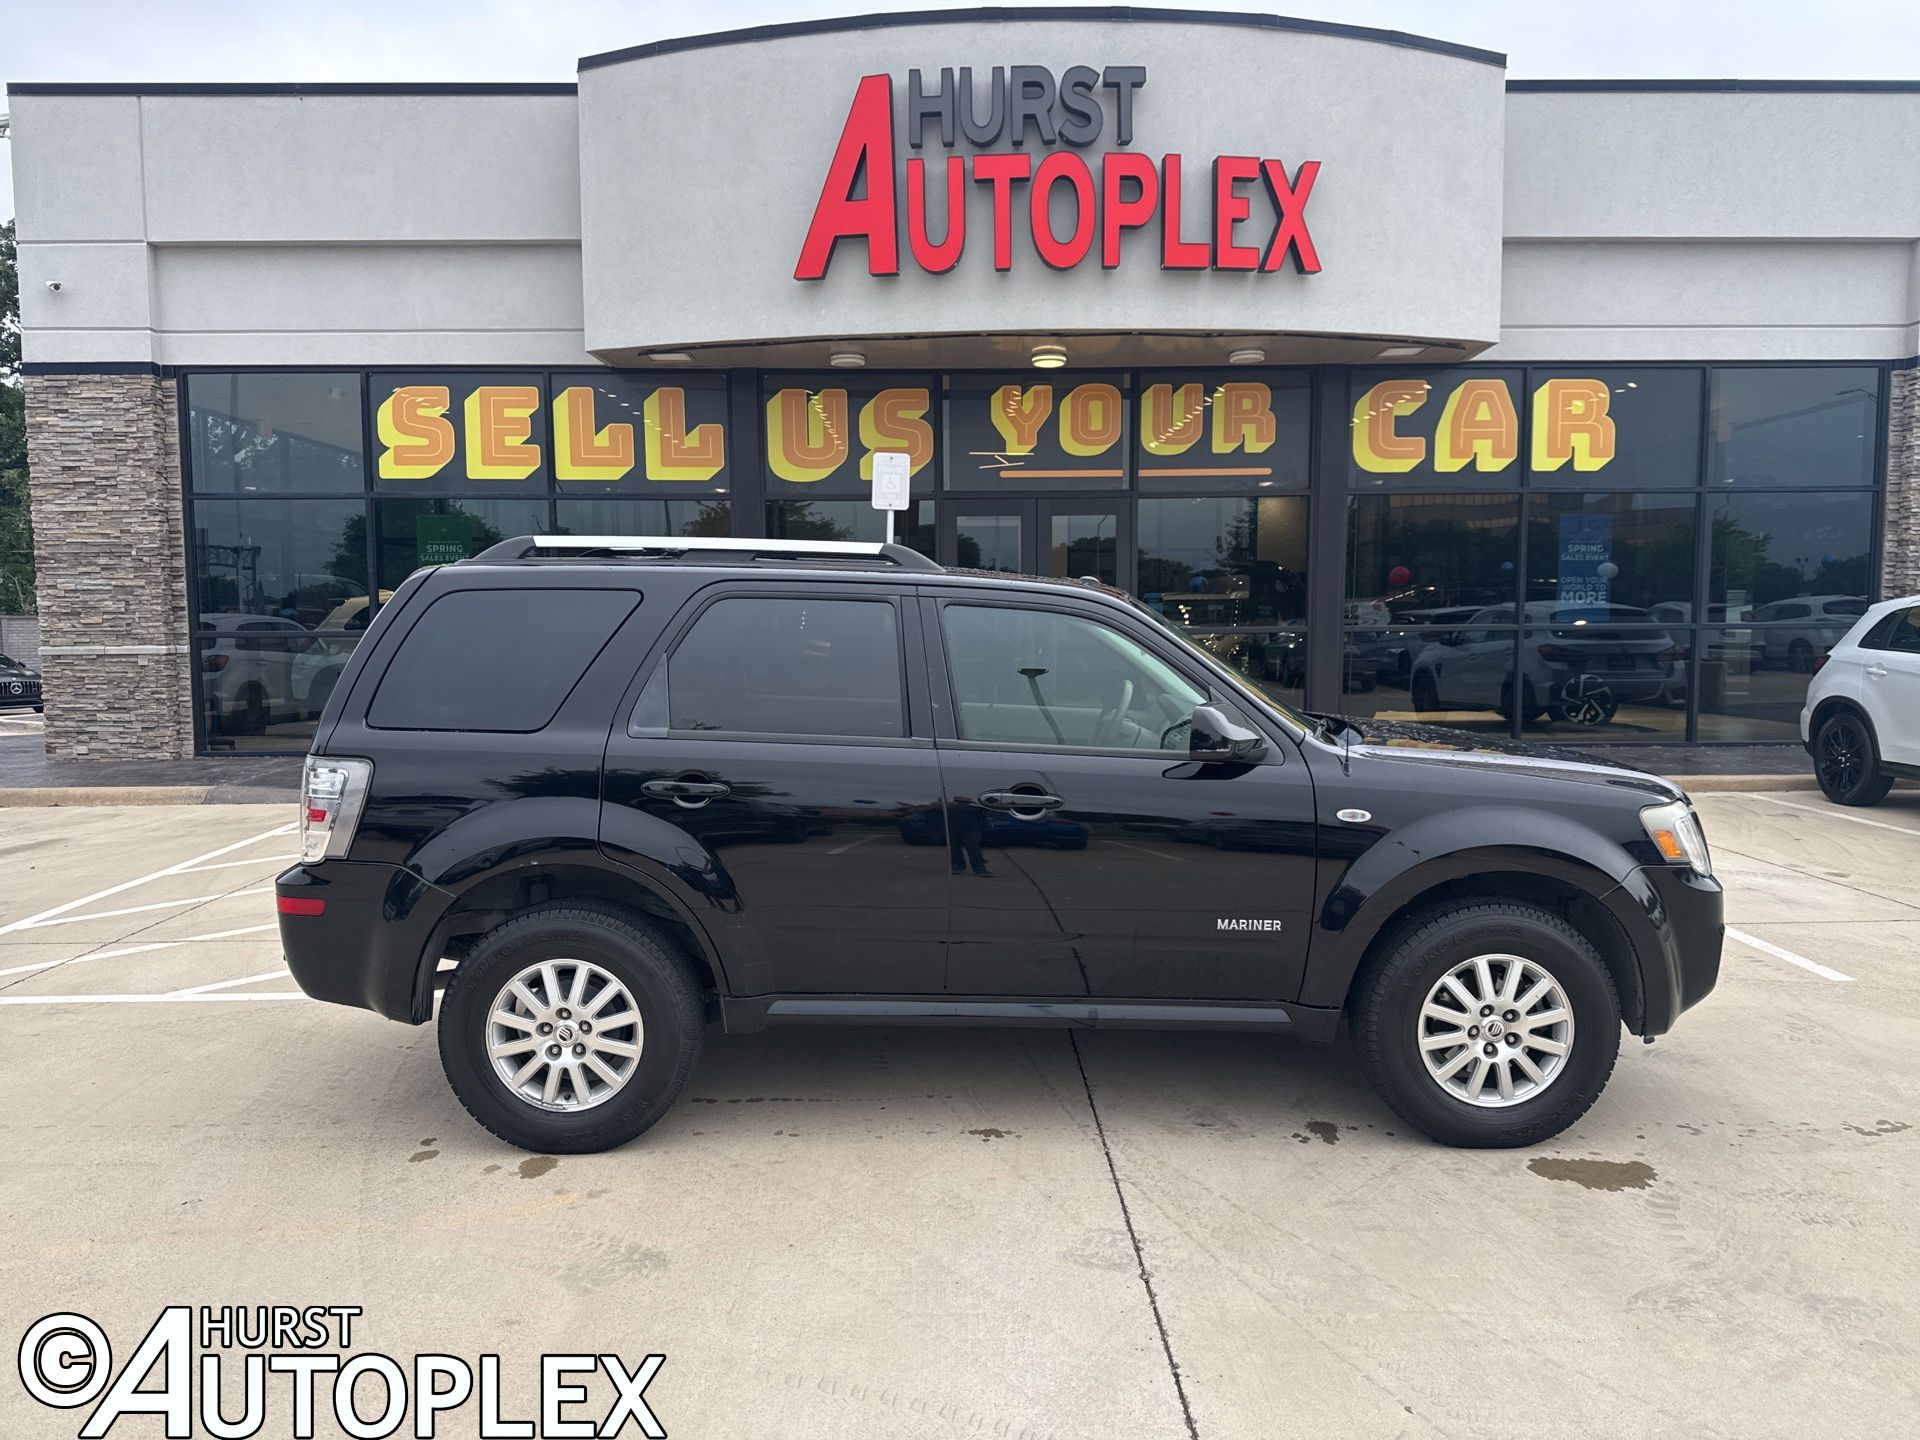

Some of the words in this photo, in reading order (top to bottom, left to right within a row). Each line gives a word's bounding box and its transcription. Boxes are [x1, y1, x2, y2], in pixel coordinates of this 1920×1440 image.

[908, 65, 1146, 148] HURST
[793, 73, 1322, 281] AUTOPLEX
[377, 386, 725, 481] SELL
[767, 388, 934, 482] US
[991, 383, 1277, 456] YOUR
[1353, 379, 1616, 473] CAR
[426, 544, 463, 553] SPRING
[1567, 544, 1604, 553] SPRING
[420, 554, 444, 562] SALES
[445, 554, 470, 562] EVENT
[1561, 576, 1584, 584] OPEN
[1585, 576, 1608, 584] YOUR
[1560, 591, 1607, 604] MORE
[1216, 918, 1282, 931] MARINER
